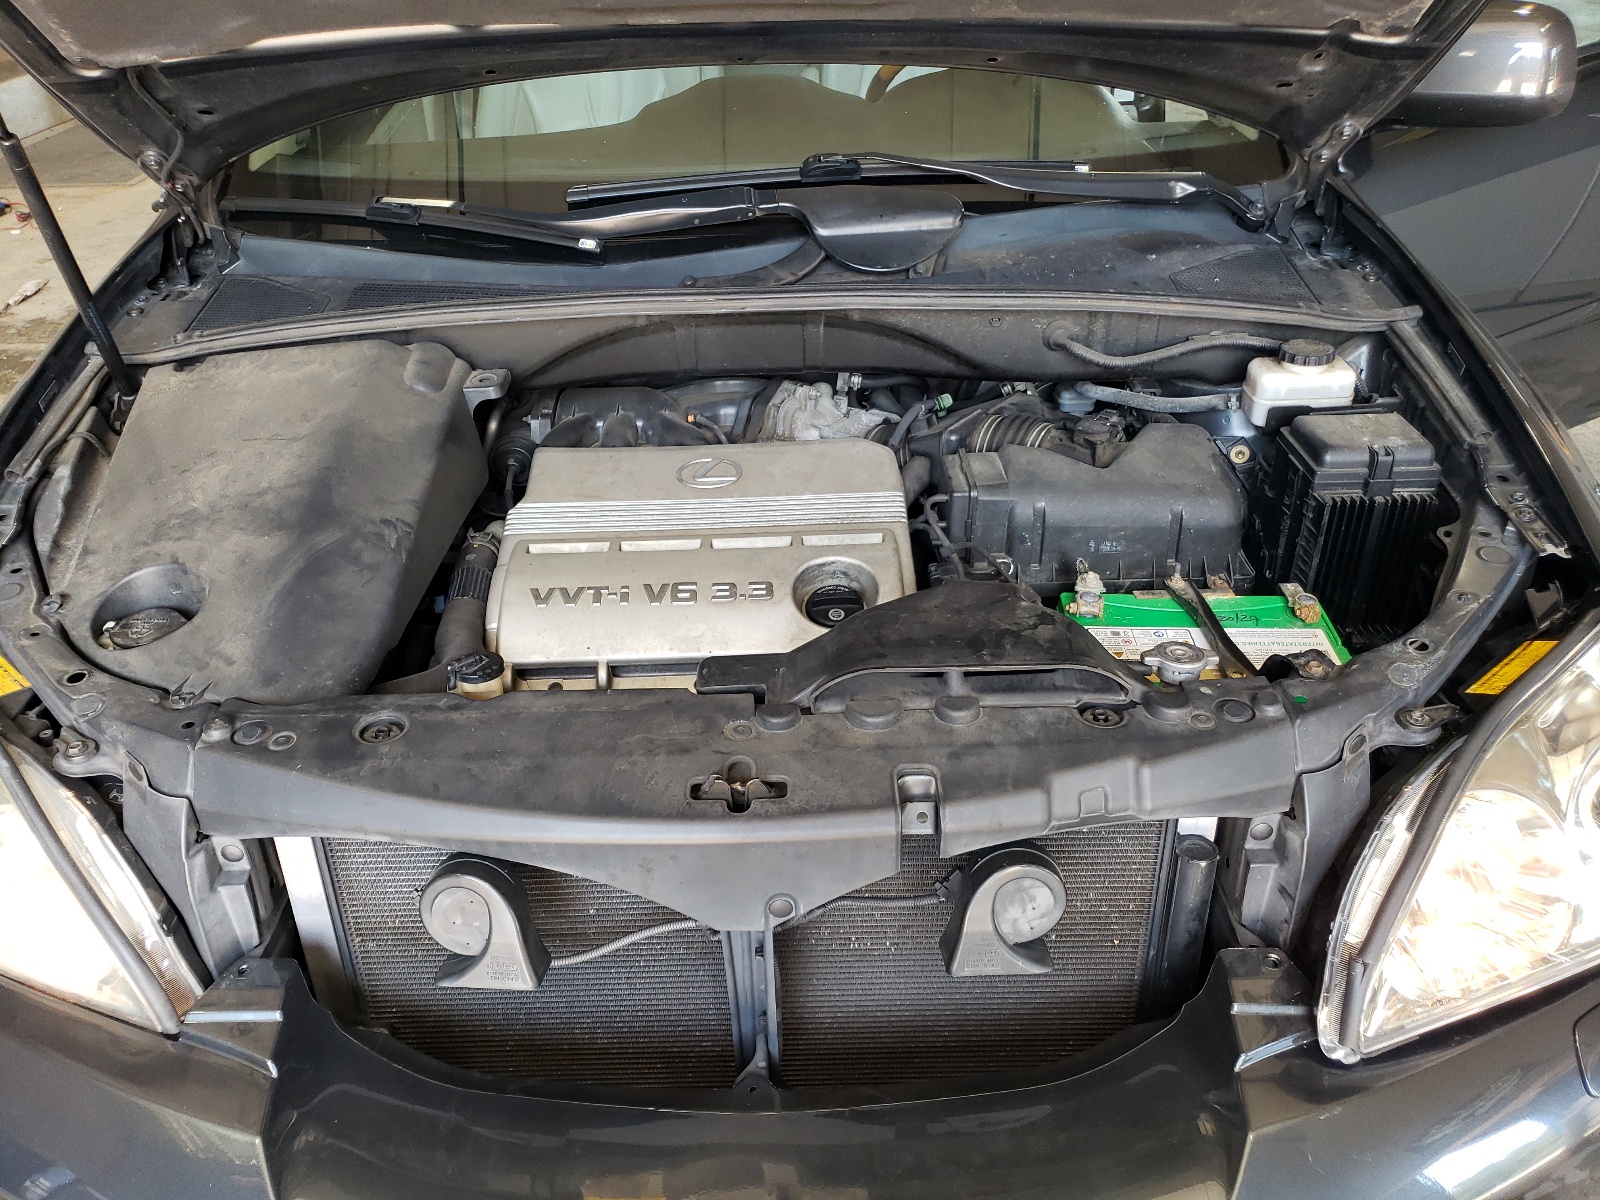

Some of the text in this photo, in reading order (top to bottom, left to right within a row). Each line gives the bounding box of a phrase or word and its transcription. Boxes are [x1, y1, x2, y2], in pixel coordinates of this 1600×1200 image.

[530, 581, 774, 607] VVT-i V6 3.3
